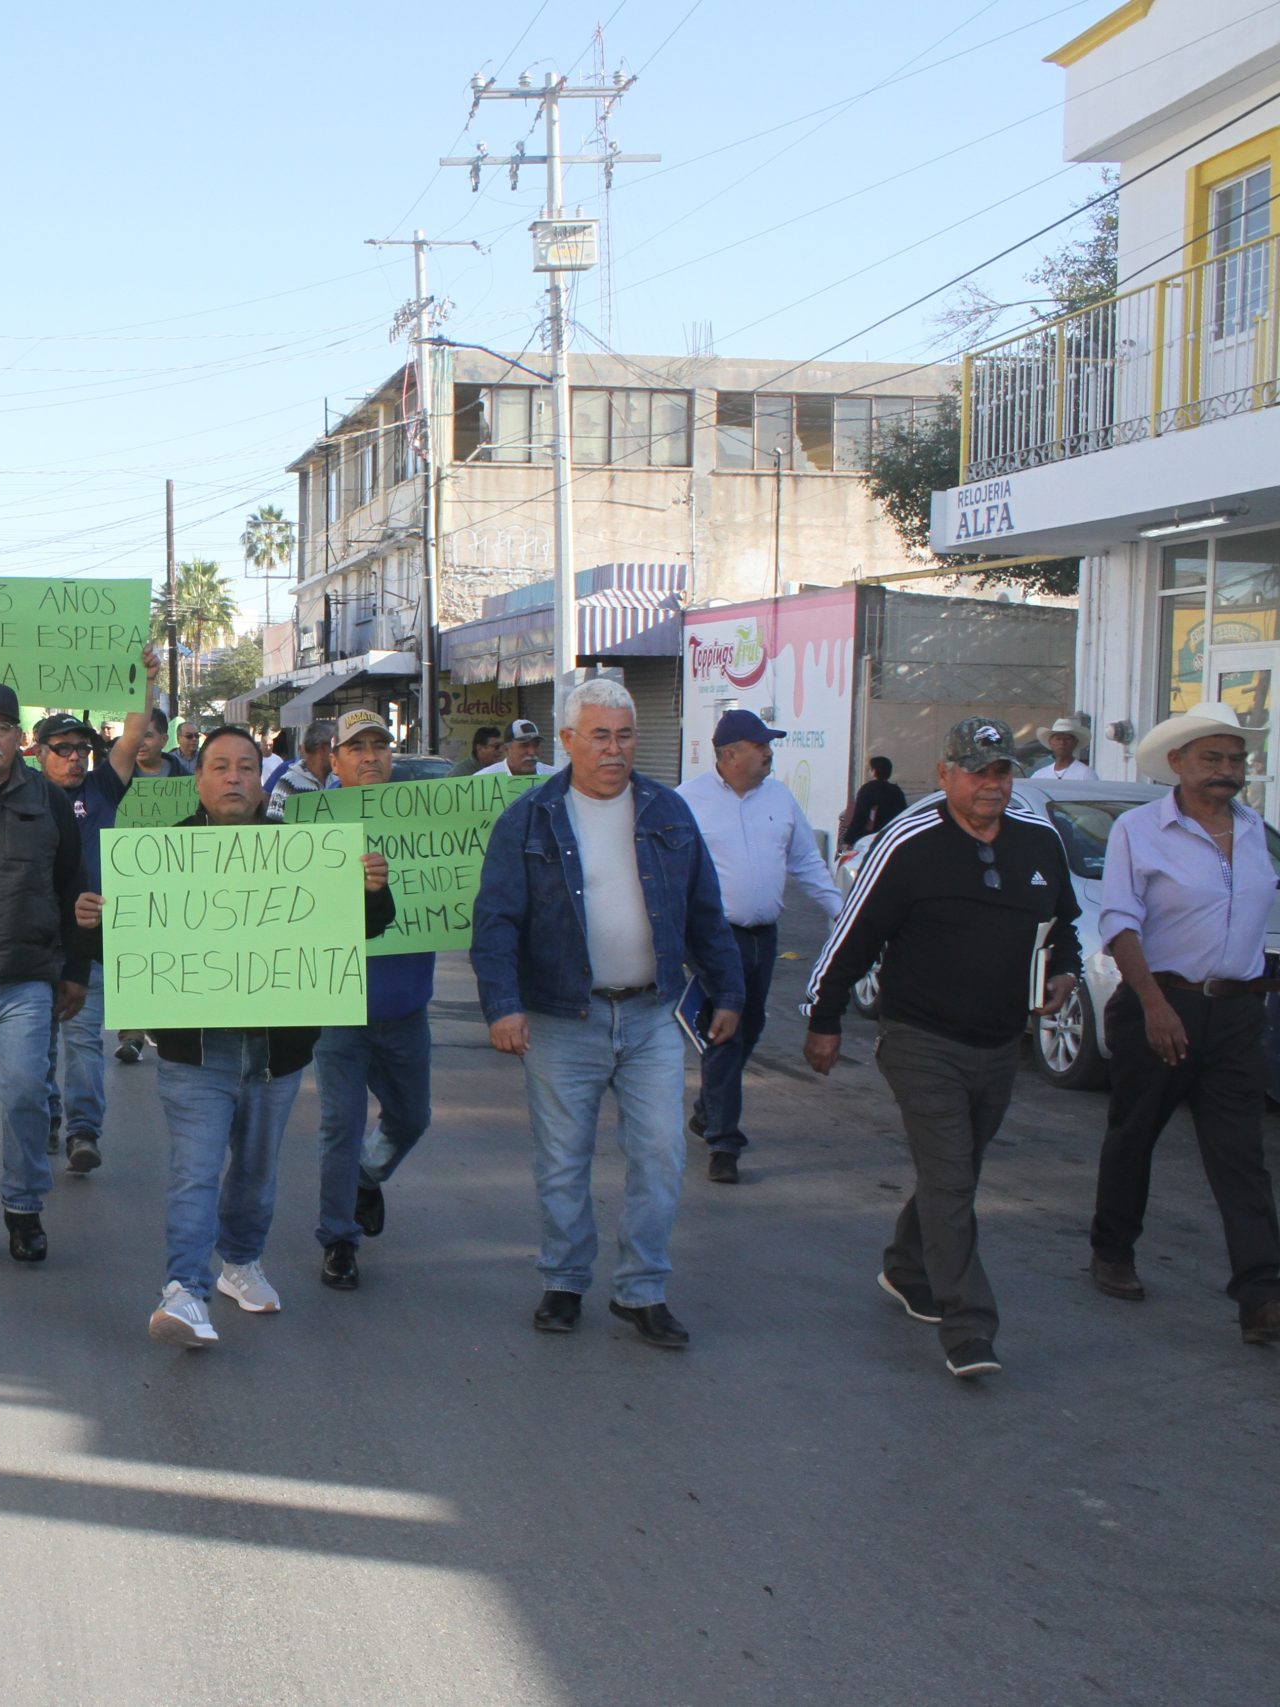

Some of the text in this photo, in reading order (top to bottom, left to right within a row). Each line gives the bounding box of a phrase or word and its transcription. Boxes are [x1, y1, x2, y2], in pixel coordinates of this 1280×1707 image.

[957, 479, 1012, 509] RELOJERIA
[955, 501, 1015, 540] ALFA
[38, 580, 116, 616] AÑOS
[36, 624, 145, 654] ESPERA
[38, 662, 137, 696] BASTA!
[456, 684, 513, 718] detalles
[295, 792, 335, 824] LA
[359, 777, 507, 819] ECONOMIA
[110, 829, 348, 877] CONFIAMOS
[112, 885, 316, 931] EN USTED
[116, 945, 364, 995] PRESIDENTA
